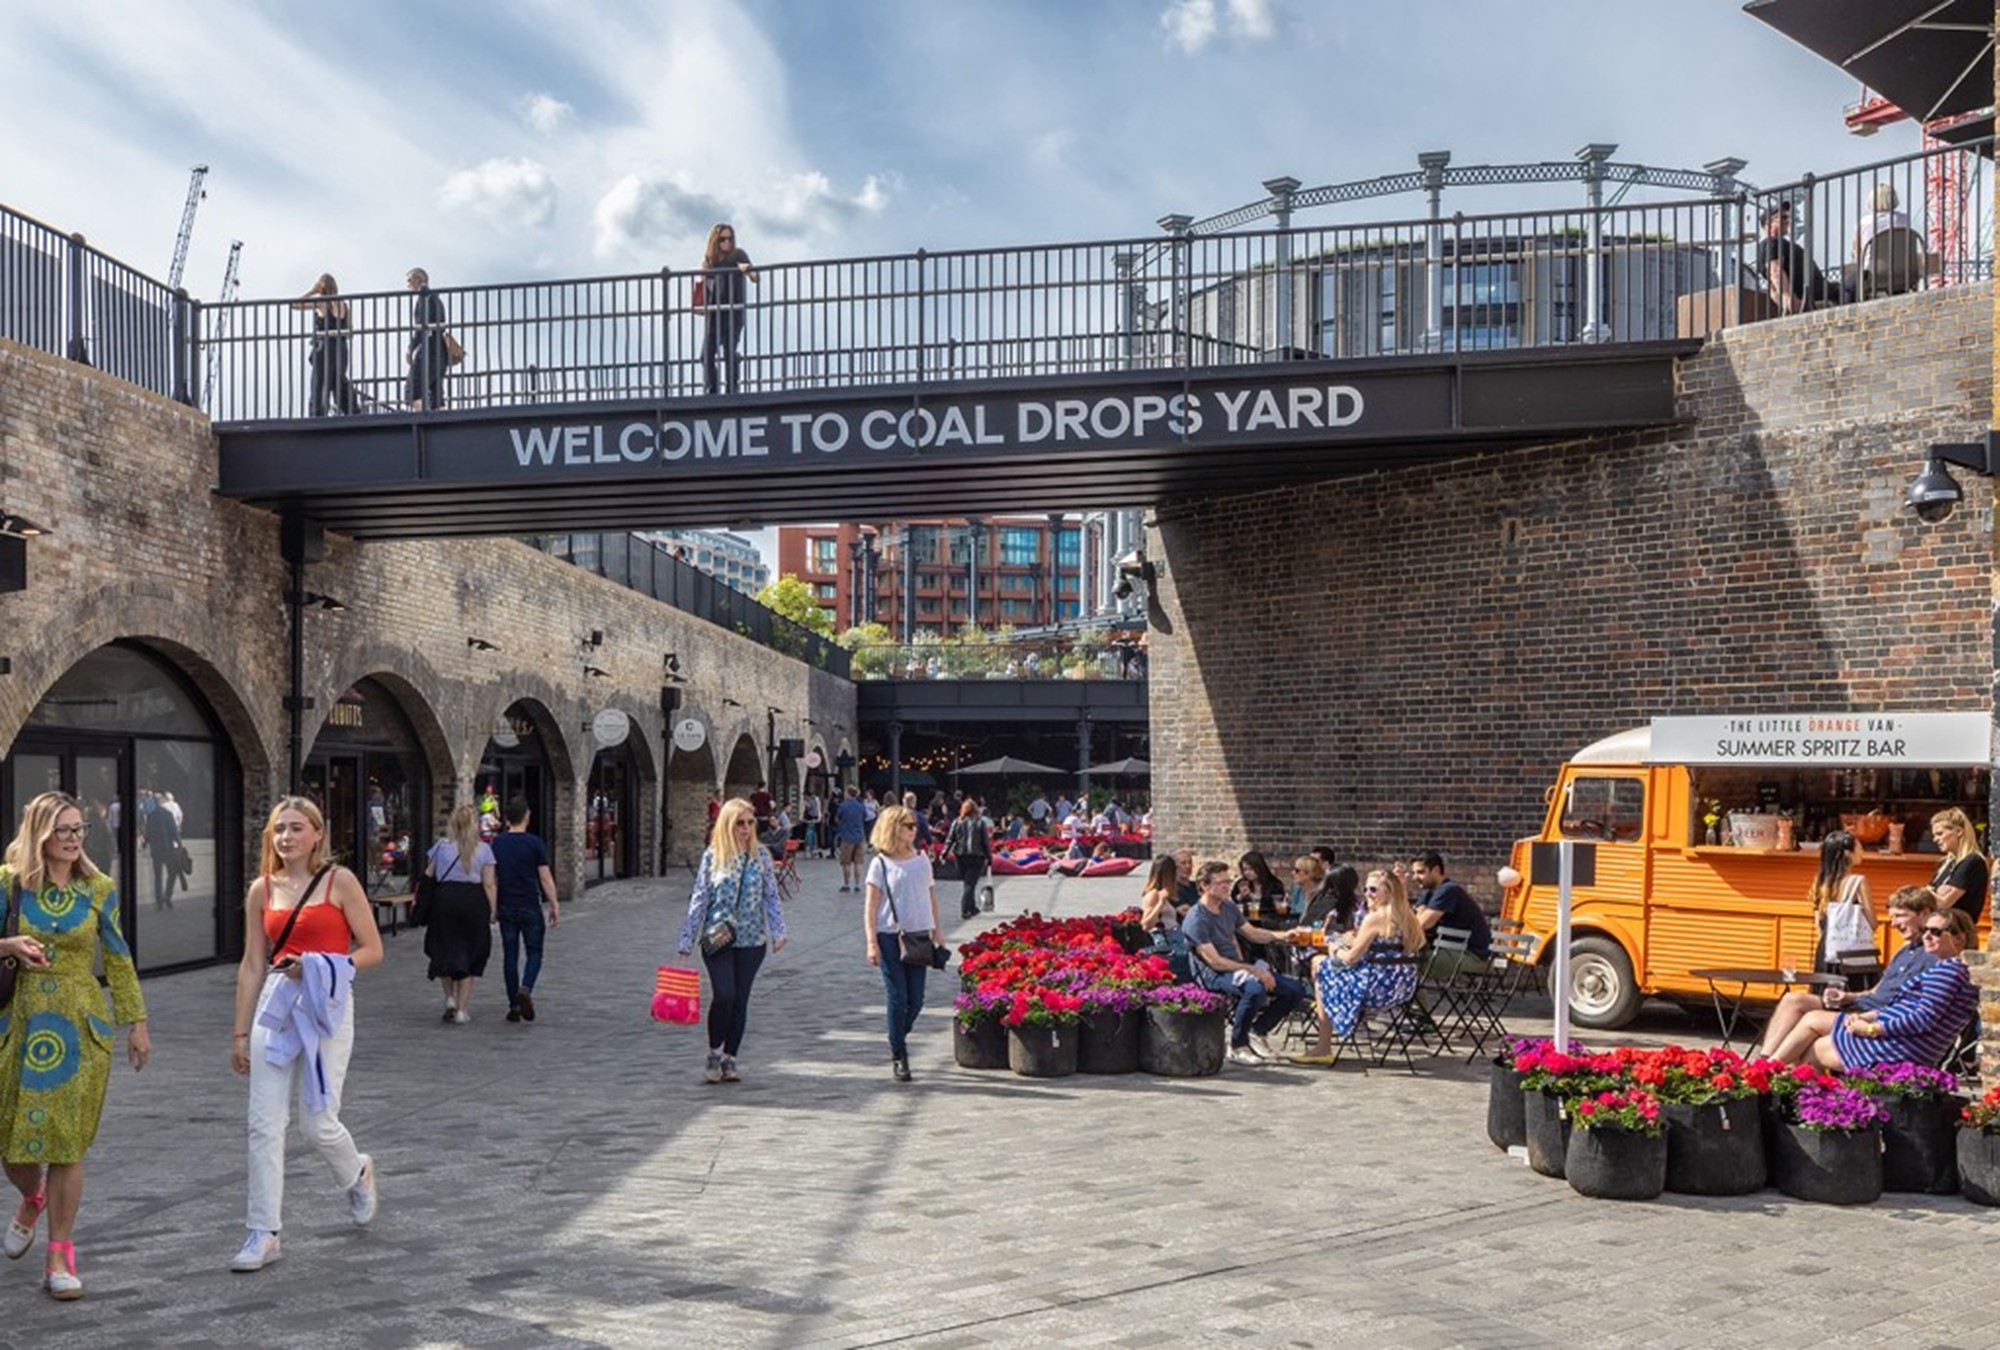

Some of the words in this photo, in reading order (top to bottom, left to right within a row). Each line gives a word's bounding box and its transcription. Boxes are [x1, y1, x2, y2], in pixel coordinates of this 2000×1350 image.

[509, 416, 769, 466] WELCOME
[780, 412, 850, 454] TO
[860, 404, 1005, 450] COAL
[1018, 394, 1203, 442] DROPS
[1214, 385, 1365, 432] YARD
[1759, 720, 1801, 732] LITTLE
[1808, 719, 1860, 732] ORANGE
[1717, 739, 1796, 757] SUMMER
[1801, 739, 1861, 757] SPRITZ
[1867, 739, 1906, 756] BAR
